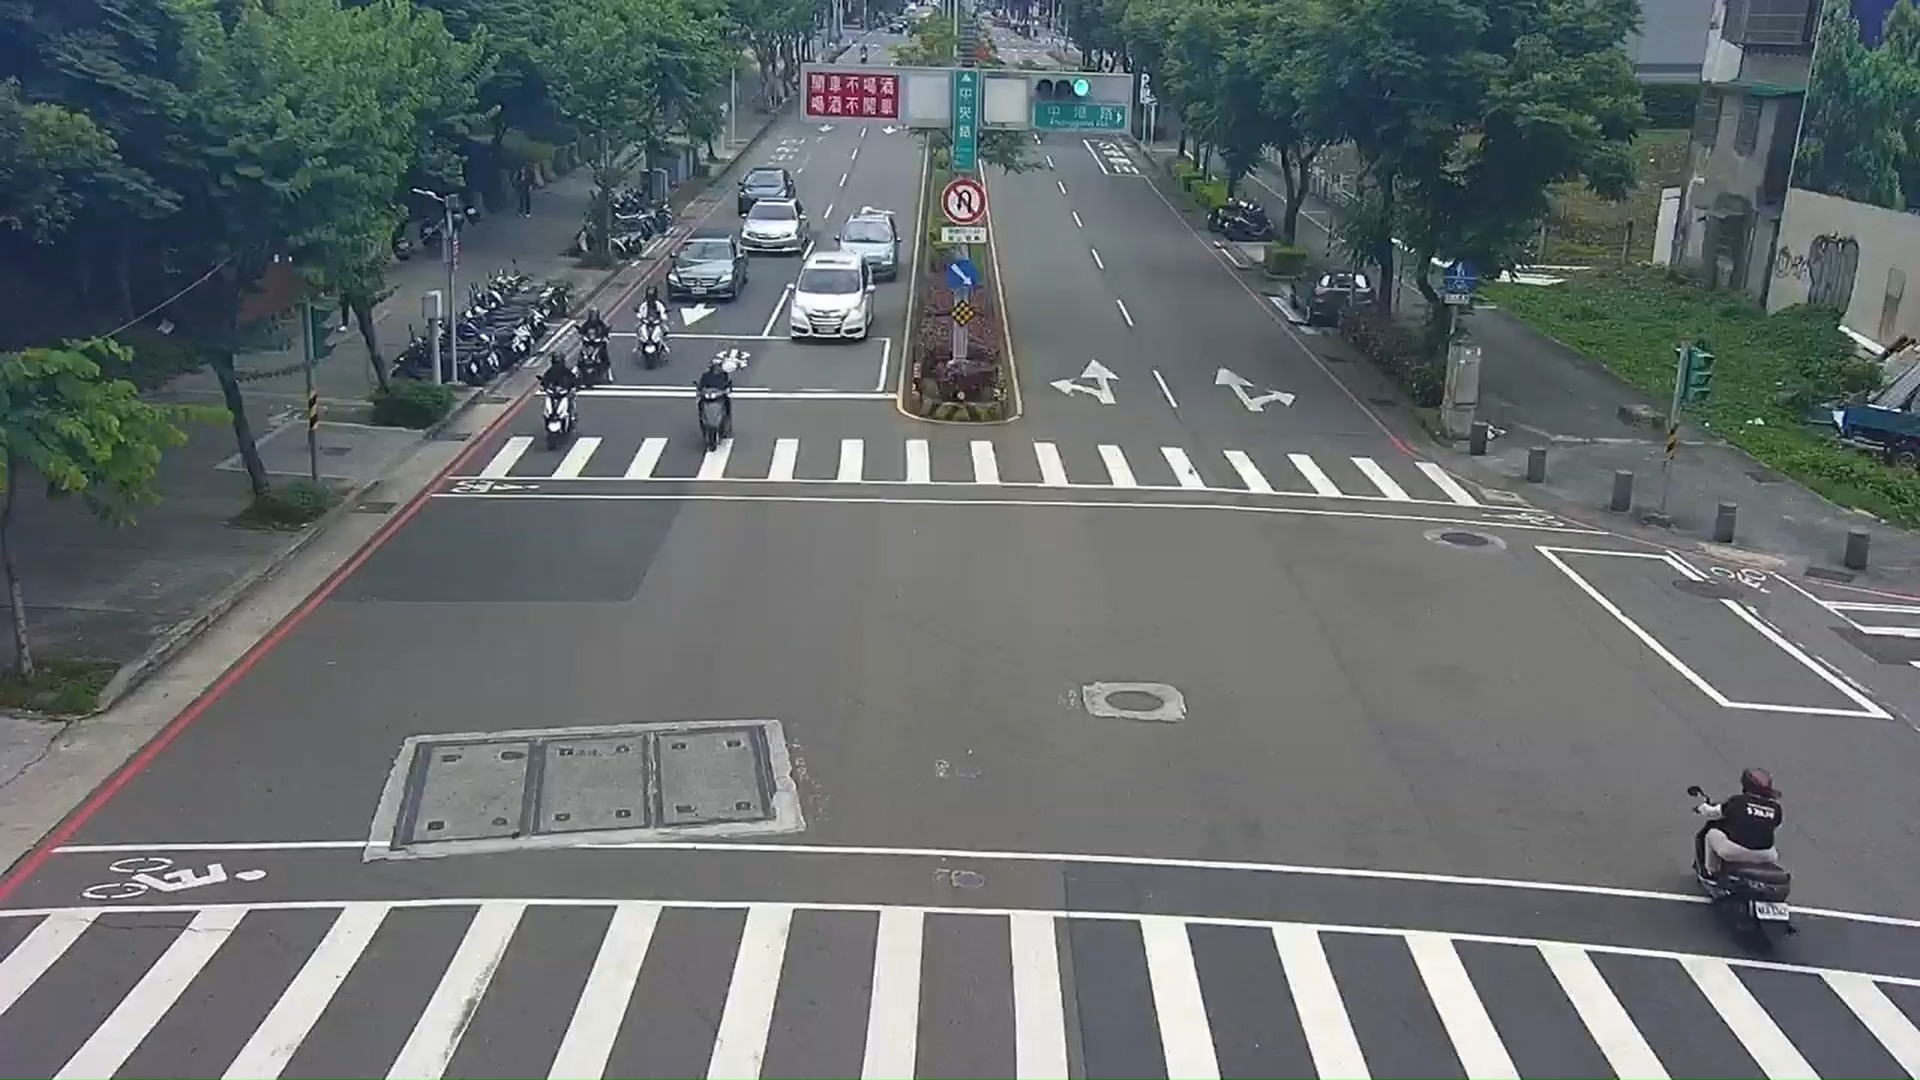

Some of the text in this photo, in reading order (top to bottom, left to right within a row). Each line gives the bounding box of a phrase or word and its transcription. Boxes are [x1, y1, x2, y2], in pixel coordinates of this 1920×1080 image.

[811, 74, 895, 95] 開車不喝酒
[811, 95, 894, 115] 喝酒不開車
[959, 87, 972, 138] 中央路
